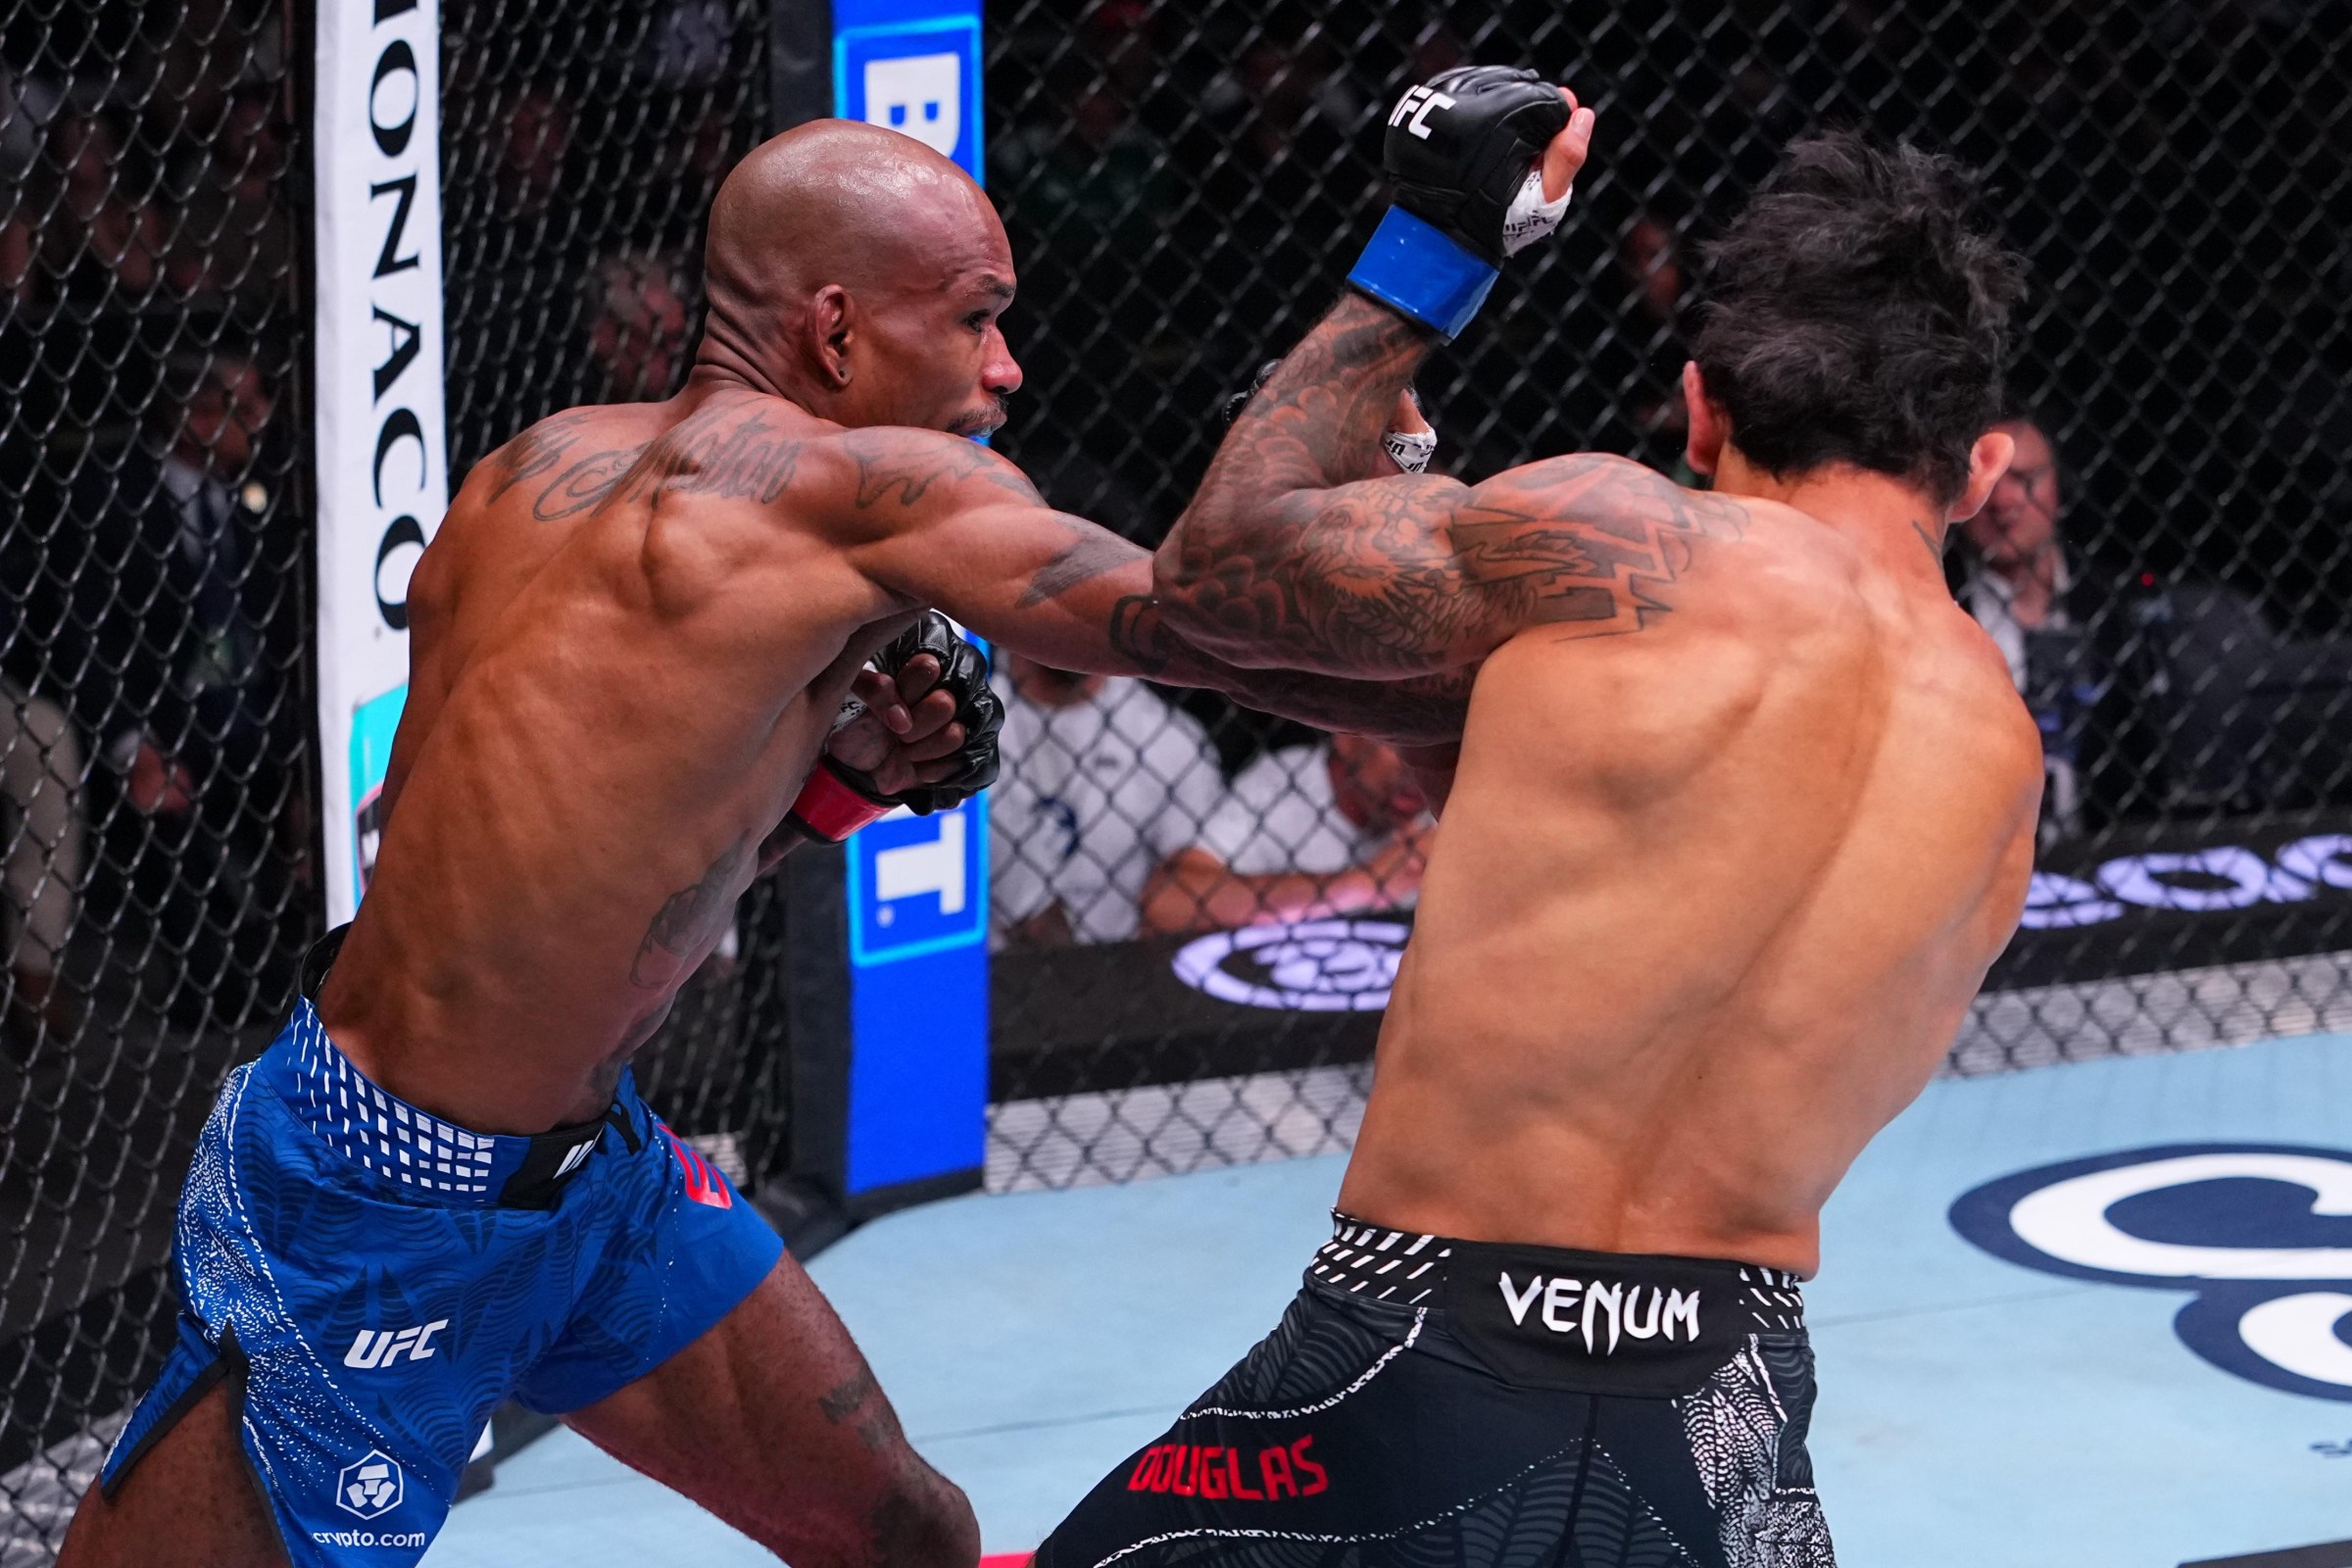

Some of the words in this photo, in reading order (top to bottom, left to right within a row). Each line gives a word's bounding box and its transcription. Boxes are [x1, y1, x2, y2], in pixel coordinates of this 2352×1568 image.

[1498, 1271, 1700, 1355] VENUM
[343, 1318, 450, 1369] UFC
[1127, 1434, 1329, 1501] DOUGLAS
[313, 1529, 425, 1548] crypto.com
